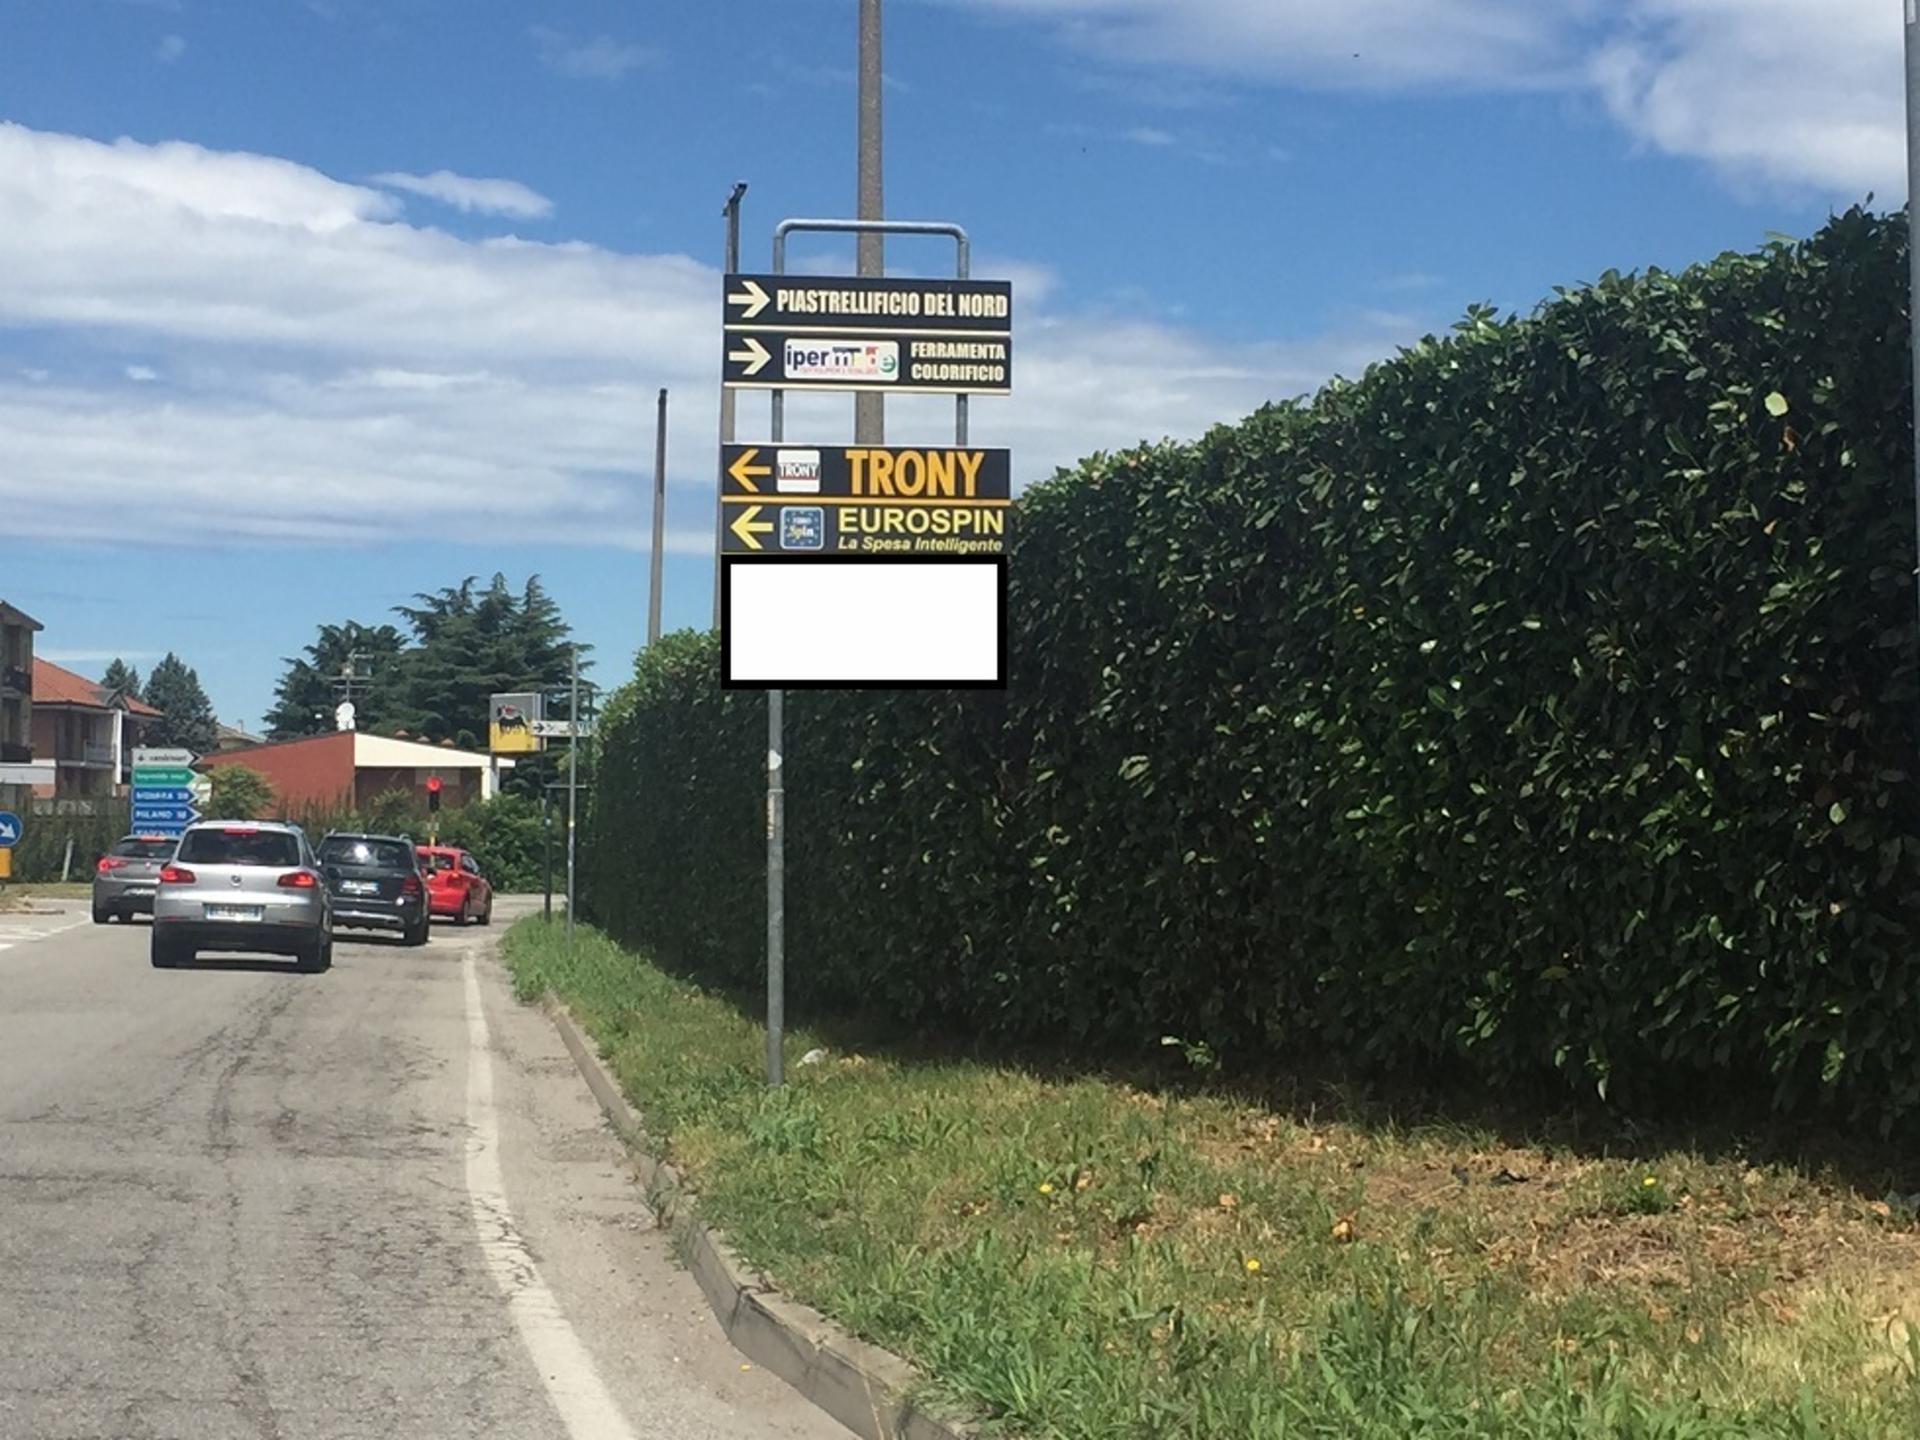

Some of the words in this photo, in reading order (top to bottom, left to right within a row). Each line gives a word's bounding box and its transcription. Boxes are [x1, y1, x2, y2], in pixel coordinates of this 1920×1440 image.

[777, 289, 921, 316] PIASTRELLIFICIO
[924, 292, 956, 317] DEL
[958, 293, 1008, 318] NORD
[910, 342, 1006, 360] FERRAMENTA
[911, 363, 1005, 382] COLORIFICIO
[778, 463, 819, 477] TRONY
[845, 449, 985, 497] TRONY
[838, 508, 1004, 535] EUROSPIN
[837, 537, 859, 550] La
[861, 537, 912, 553] Spesa
[915, 539, 1004, 555] Intelligente
[136, 810, 173, 819] MILANO
